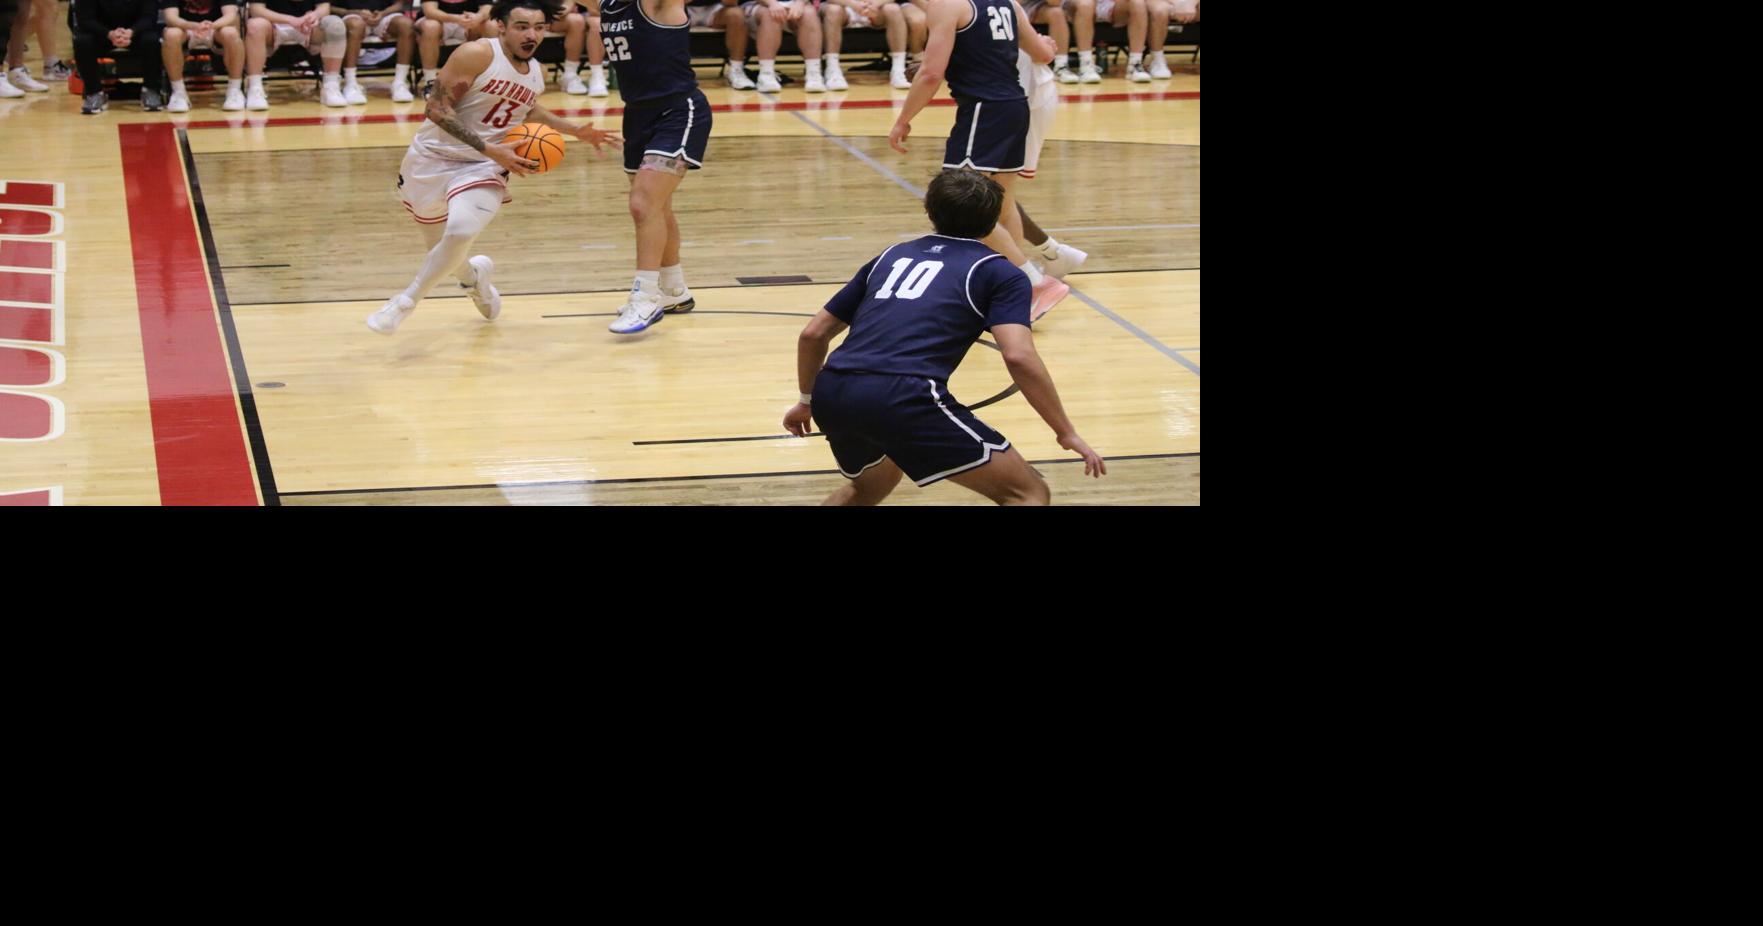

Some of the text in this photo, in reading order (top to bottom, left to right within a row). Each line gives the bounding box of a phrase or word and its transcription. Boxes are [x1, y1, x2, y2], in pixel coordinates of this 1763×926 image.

[987, 6, 1014, 41] 20
[603, 36, 632, 61] 22
[480, 79, 510, 95] RED
[481, 98, 521, 128] 13
[874, 257, 944, 300] 10
